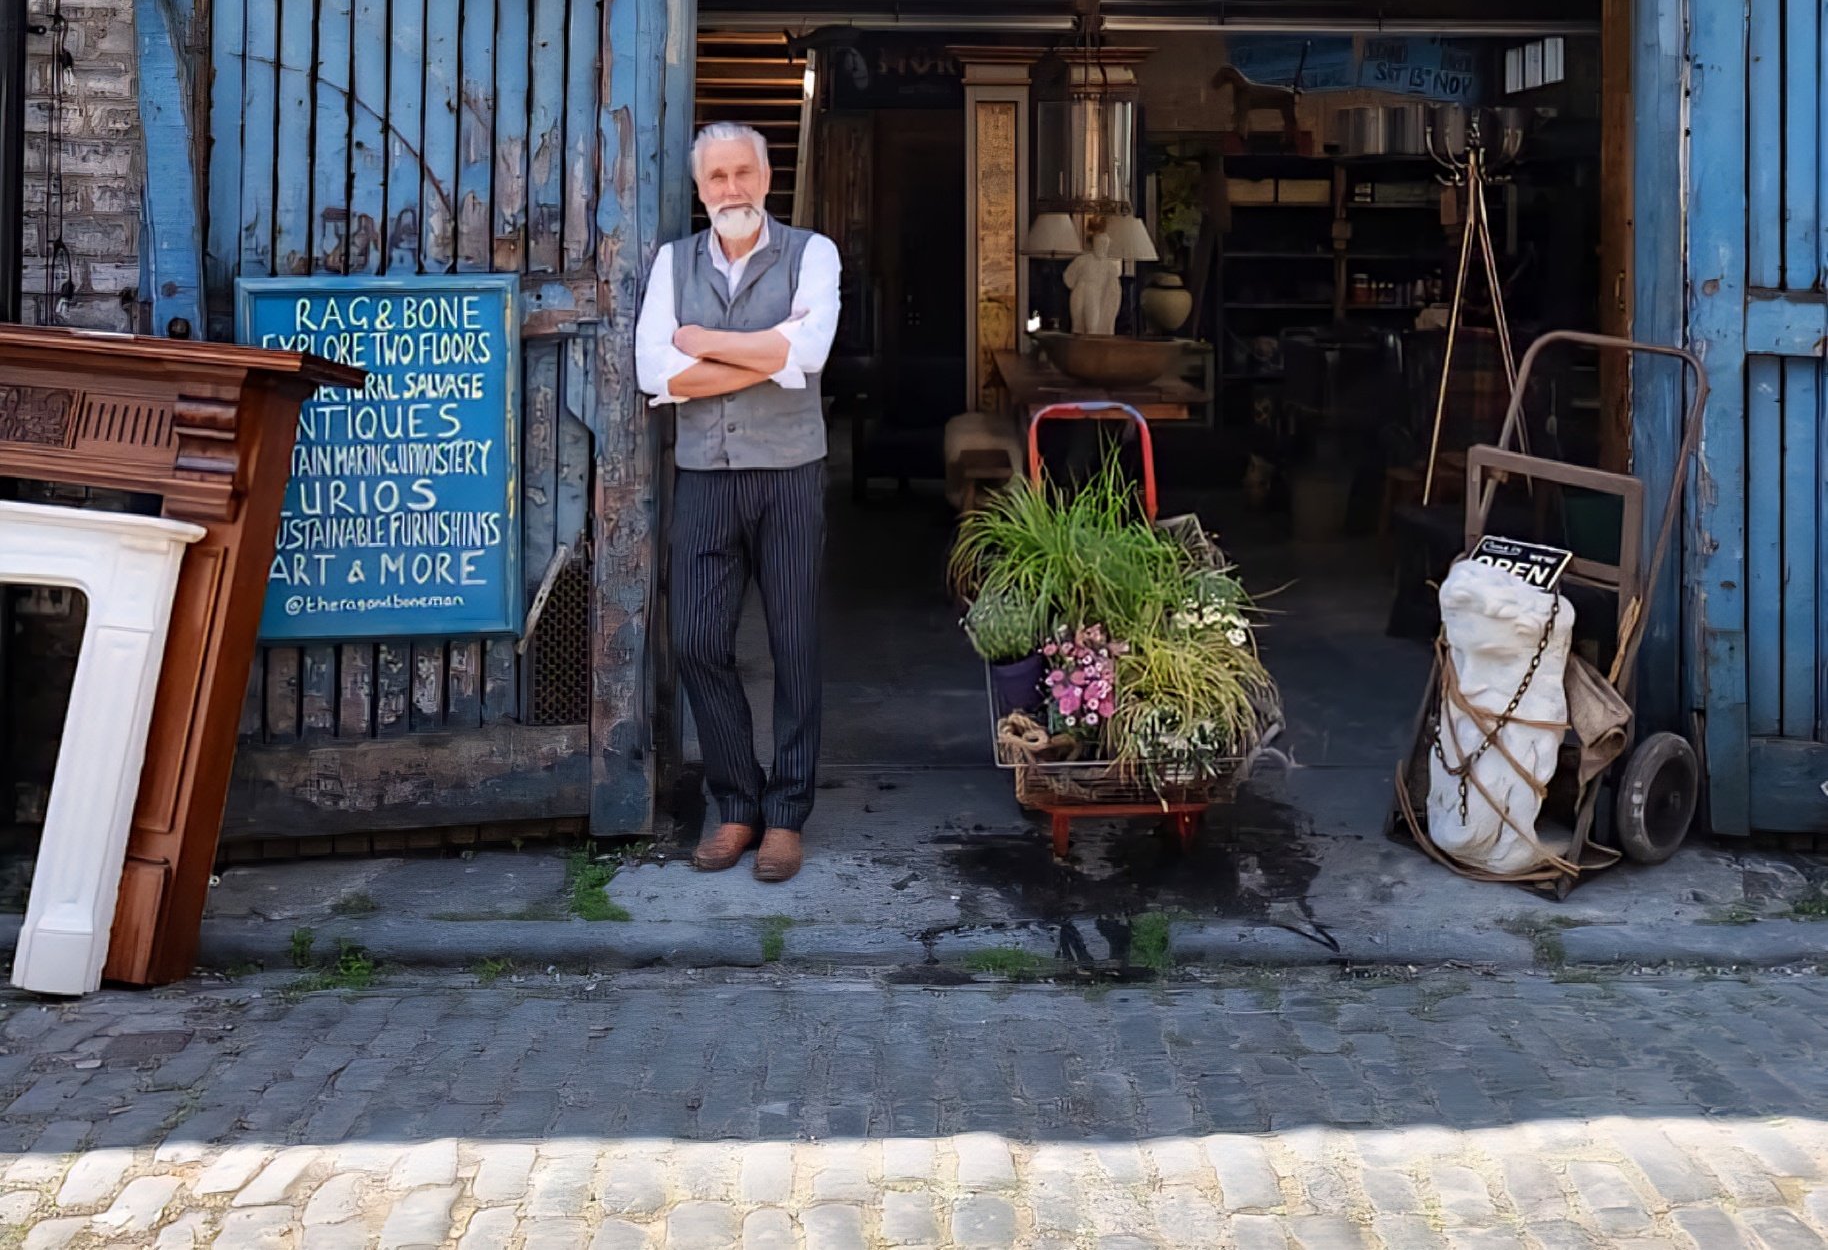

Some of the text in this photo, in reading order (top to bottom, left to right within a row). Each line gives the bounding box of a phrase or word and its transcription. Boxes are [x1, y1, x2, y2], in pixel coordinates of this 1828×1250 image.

[295, 295, 482, 331] RAG & BONE
[369, 330, 415, 366] TWO
[419, 331, 492, 366] FLOORS
[403, 372, 485, 400] SALVAGE
[296, 402, 462, 440] NTIQUES
[281, 478, 438, 517] URIOS
[276, 515, 387, 550] USTAINABLE
[268, 549, 488, 586] ART & MORE
